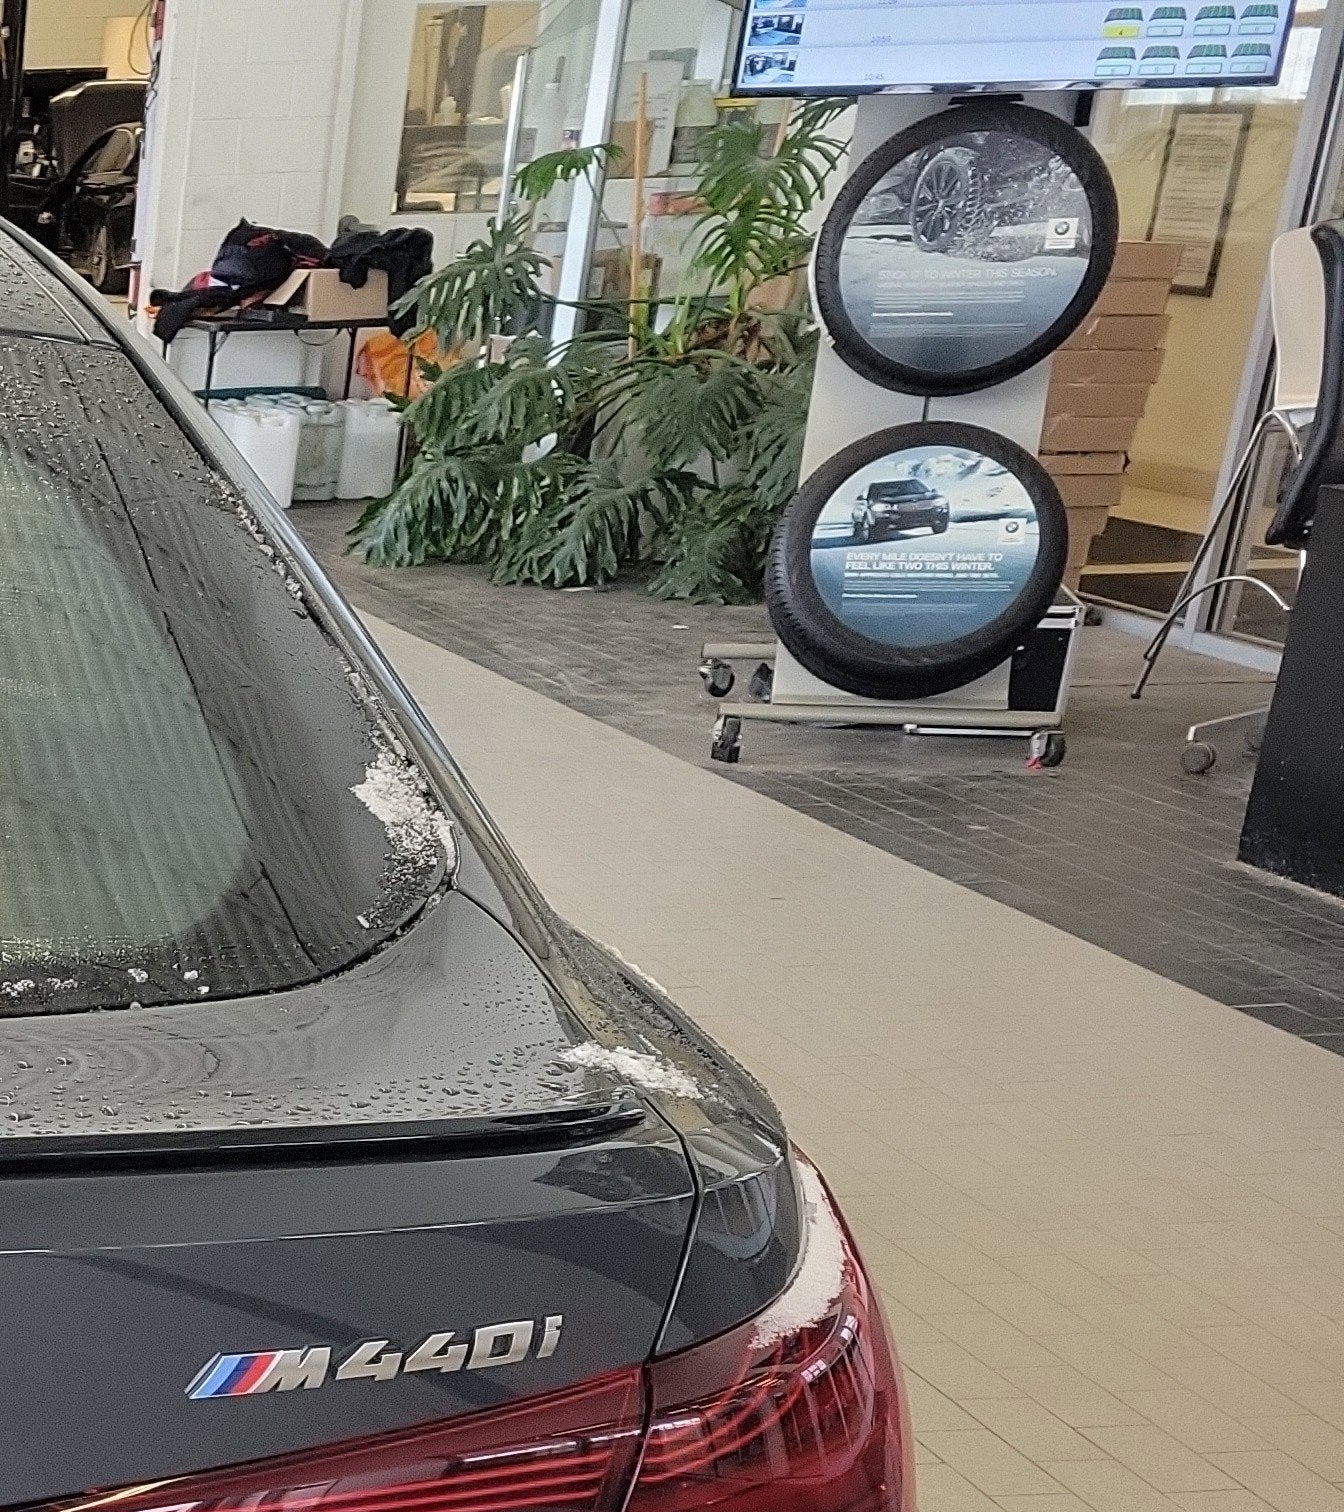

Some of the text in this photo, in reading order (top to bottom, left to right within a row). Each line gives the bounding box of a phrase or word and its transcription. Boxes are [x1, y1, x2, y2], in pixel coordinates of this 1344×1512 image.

[985, 268, 1009, 278] THIS
[846, 552, 881, 561] EVERY
[882, 552, 907, 561] MILE
[957, 552, 987, 561] HAVE
[988, 552, 1003, 562] TO
[844, 561, 995, 571] FEEL LIKE TWO THIS WINTER.
[250, 1314, 563, 1393] M440i
